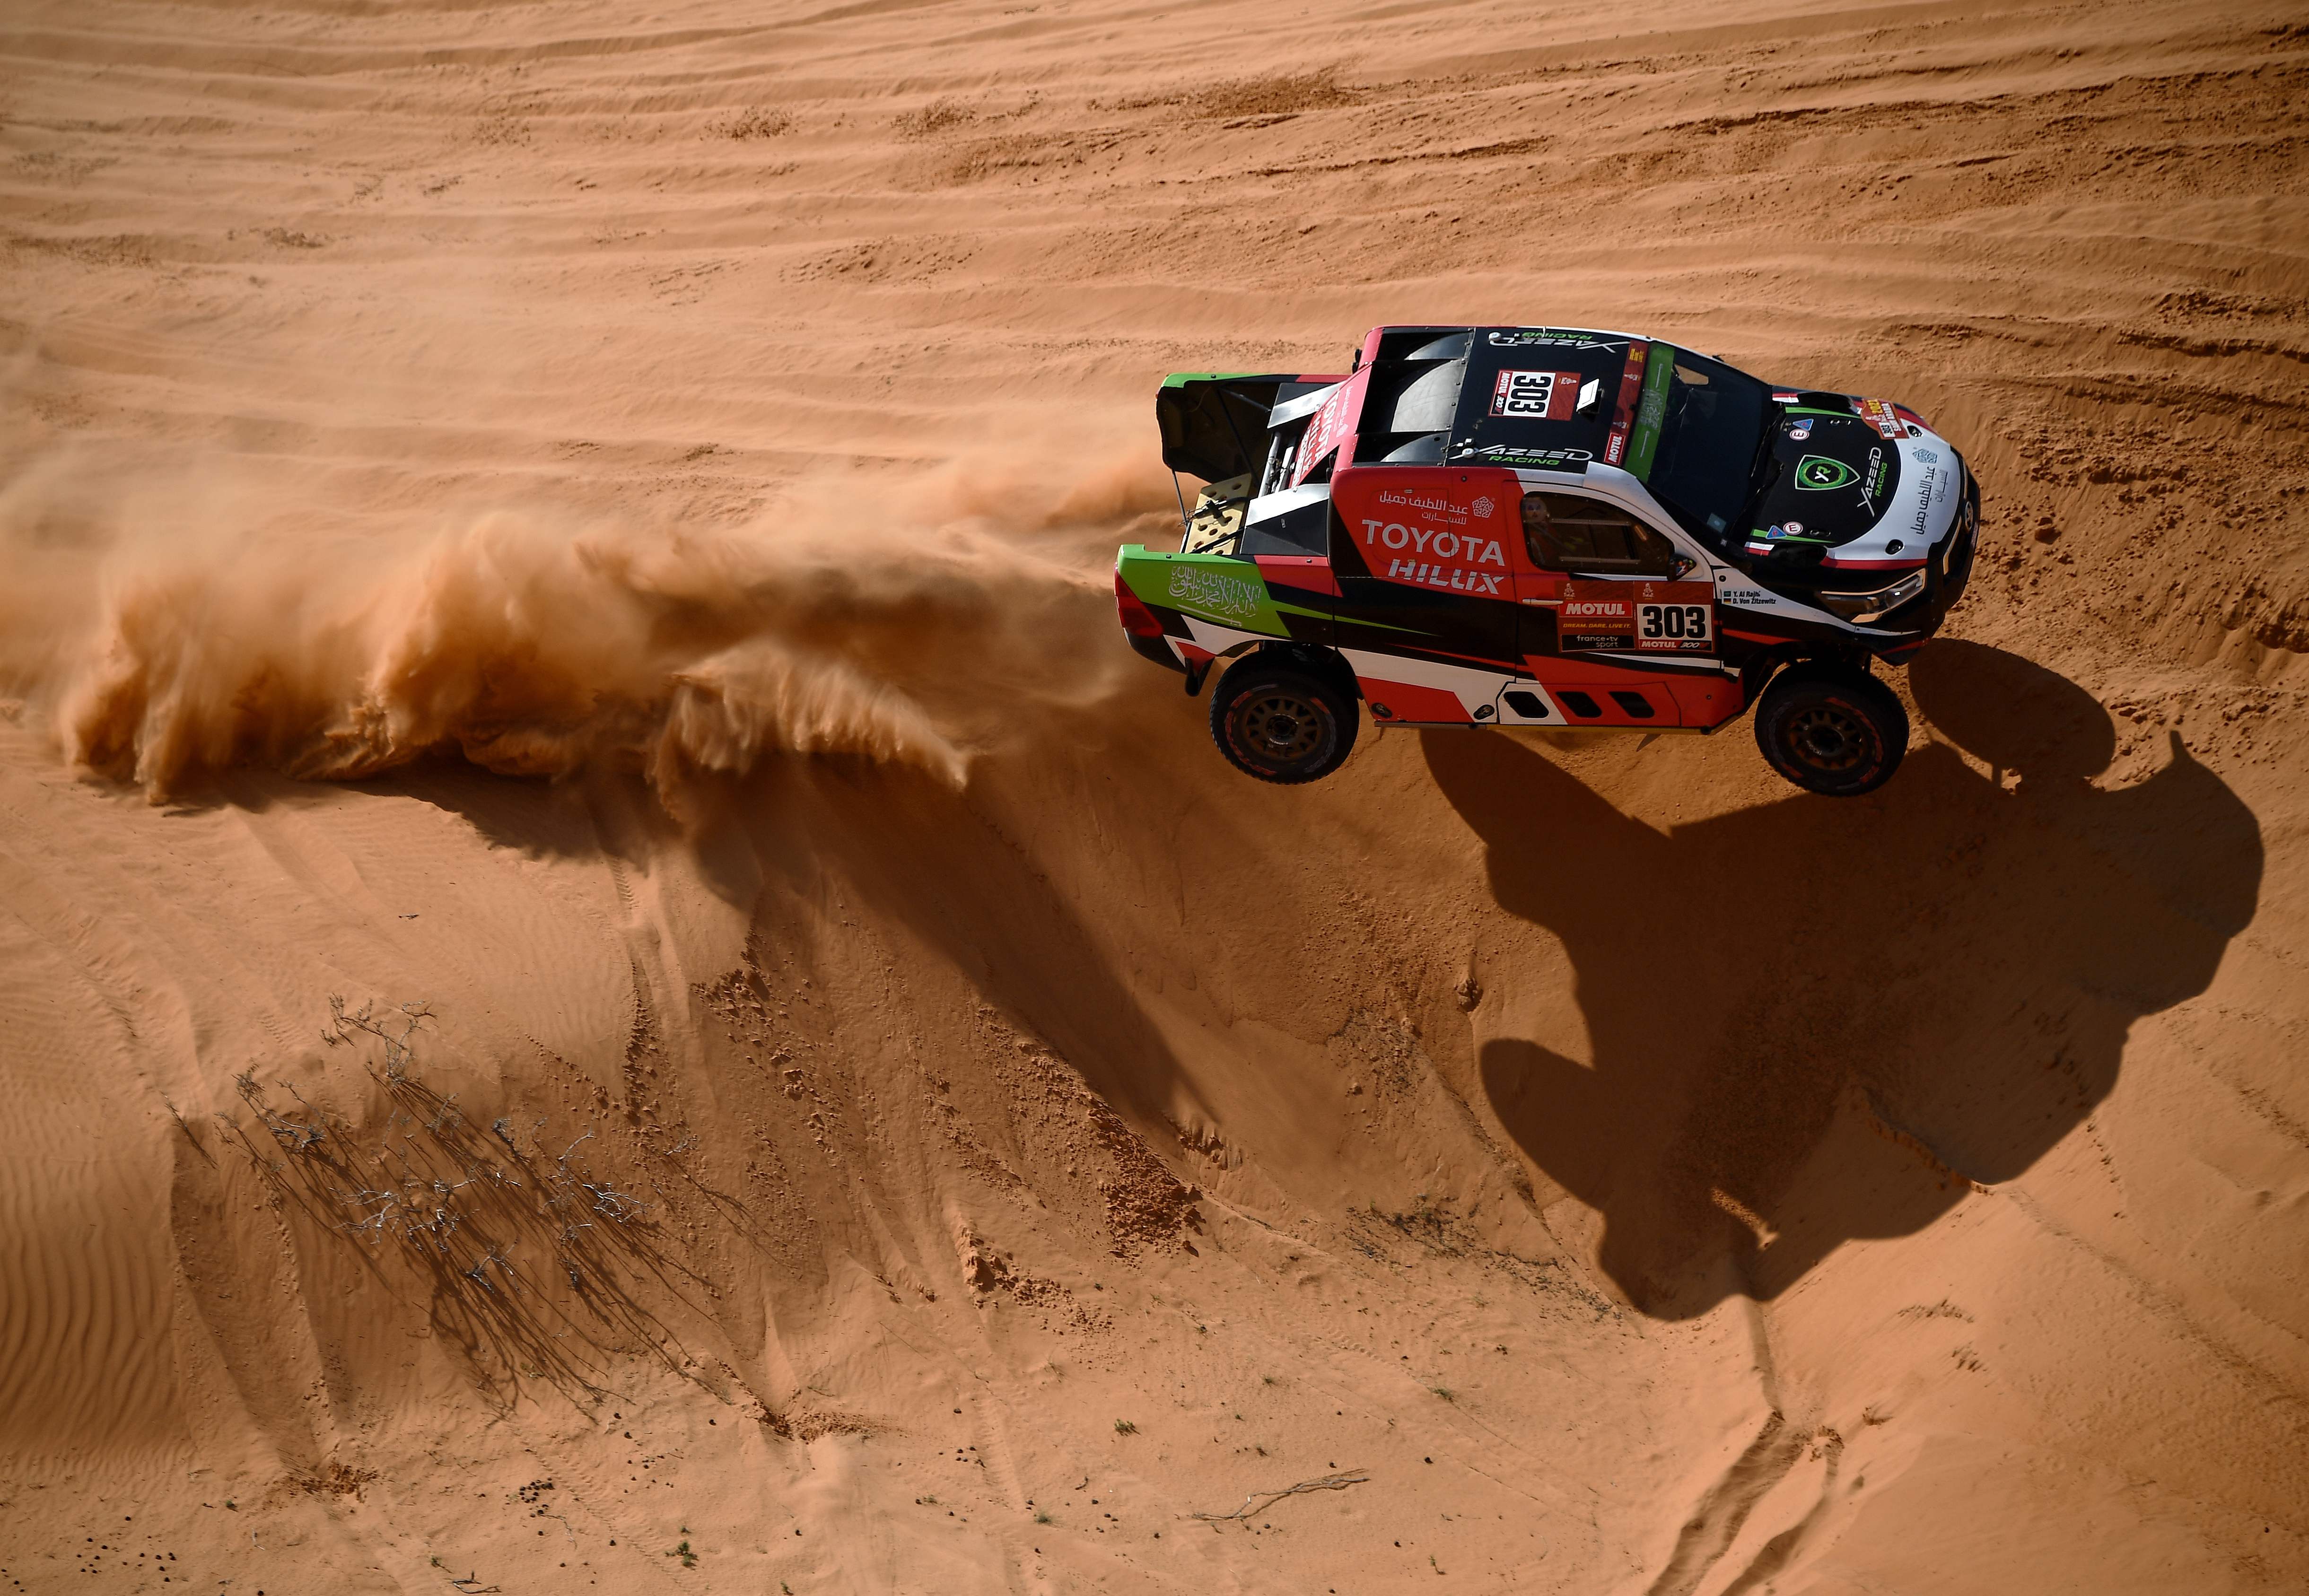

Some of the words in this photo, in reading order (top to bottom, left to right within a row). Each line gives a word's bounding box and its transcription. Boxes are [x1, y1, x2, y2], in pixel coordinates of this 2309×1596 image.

[1522, 332, 1592, 340] RACING
[1498, 372, 1511, 394] MOTUL
[1508, 375, 1552, 413] 303
[1312, 390, 1340, 465] TOYOTA
[1448, 444, 1593, 461] YAZEED
[1488, 455, 1561, 465] RACING
[1608, 435, 1623, 462] MOTUL
[1857, 447, 1882, 517] YAZEED
[1875, 462, 1888, 497] RACING
[1379, 490, 1407, 506] جميل
[1409, 497, 1447, 511] اللطيف
[1448, 504, 1468, 515] عبد
[1910, 512, 1929, 535] جميل
[1362, 518, 1505, 567] TOYOTA
[1388, 558, 1504, 595] HILUX
[1566, 603, 1625, 615] MOTUL
[1642, 605, 1706, 638] 303
